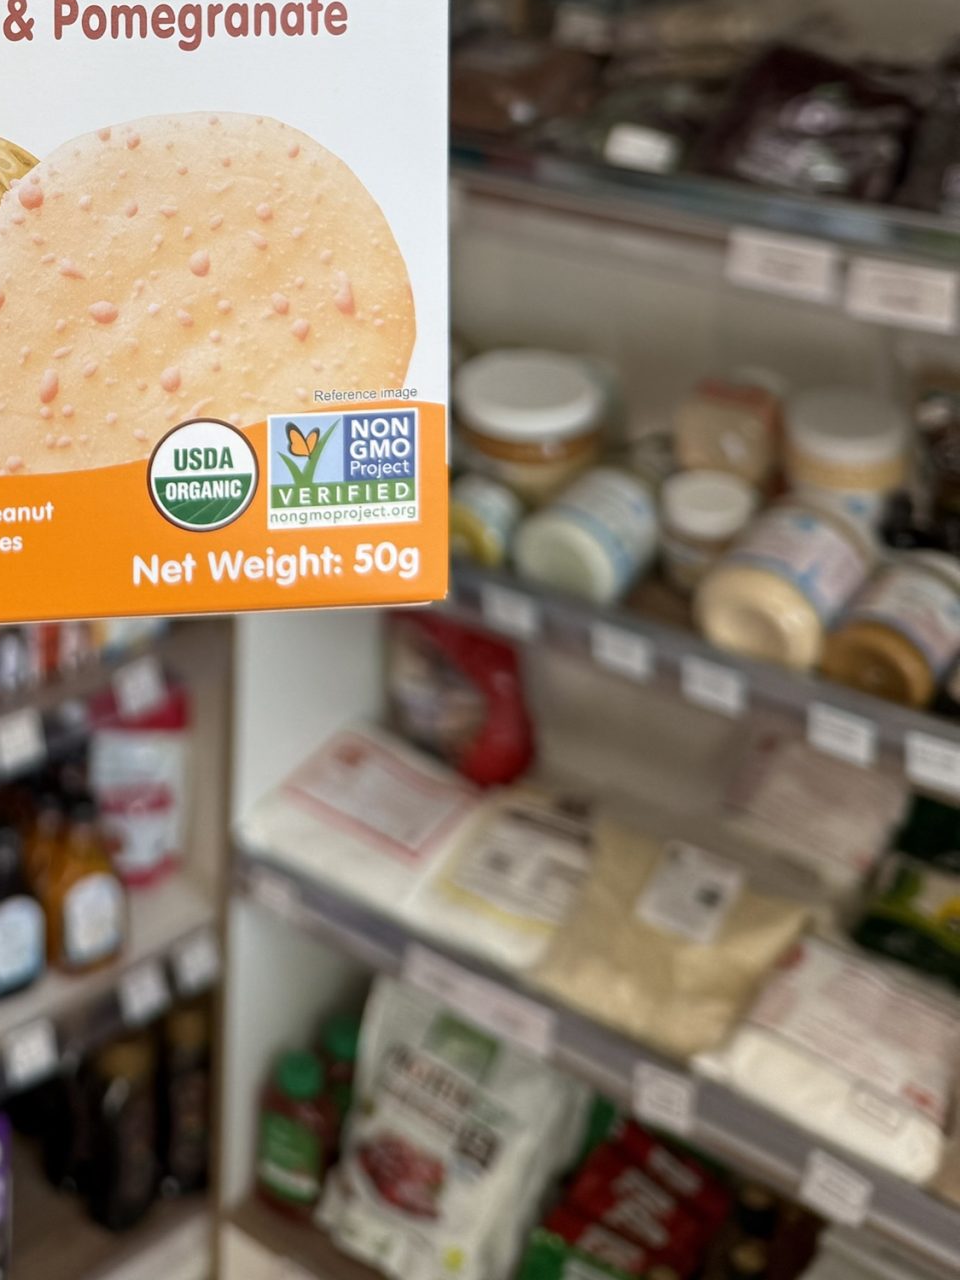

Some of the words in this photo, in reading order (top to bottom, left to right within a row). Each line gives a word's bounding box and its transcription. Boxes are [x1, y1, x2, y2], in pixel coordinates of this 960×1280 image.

[314, 389, 377, 402] Reference
[381, 387, 418, 401] image
[350, 417, 409, 439] NON
[173, 446, 234, 471] USDA
[349, 439, 410, 460] GMO
[350, 460, 410, 478] Project
[165, 479, 242, 500] ORGANIC
[279, 482, 410, 506] VERIFIED
[270, 505, 416, 524] nongmoproject.org
[132, 553, 196, 586] Net
[207, 545, 342, 585] Weight:
[353, 542, 419, 579] 50g
